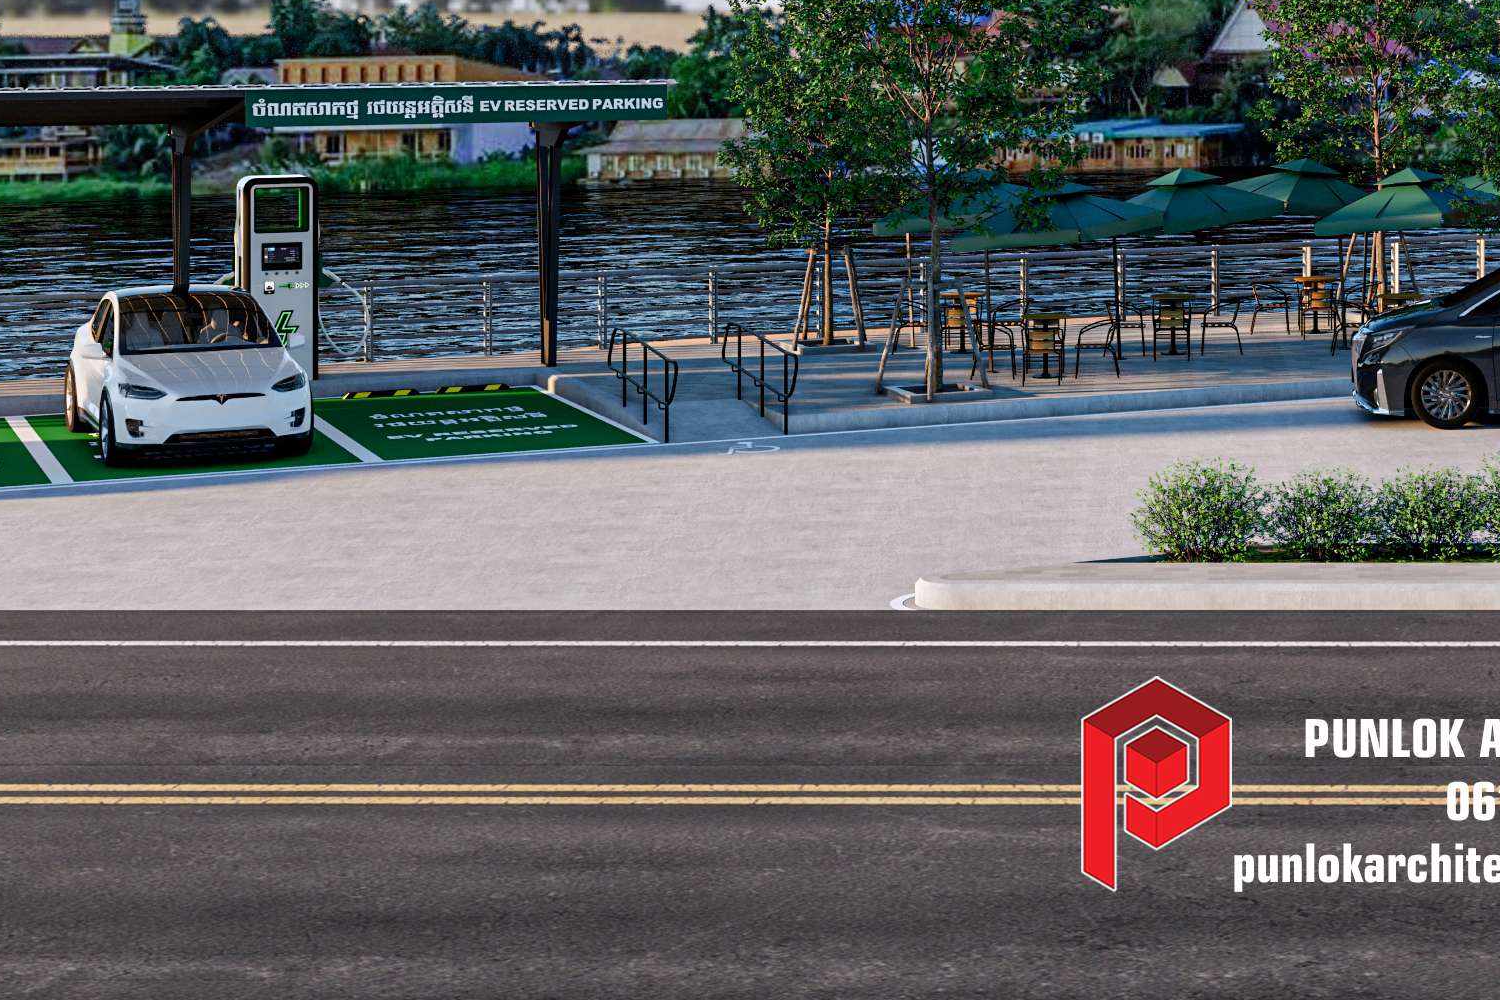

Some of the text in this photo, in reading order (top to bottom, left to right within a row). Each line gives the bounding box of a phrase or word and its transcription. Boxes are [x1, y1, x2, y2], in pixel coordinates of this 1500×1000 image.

[479, 100, 501, 112] EV
[504, 98, 589, 112] RESERVED
[592, 97, 664, 110] PARKING
